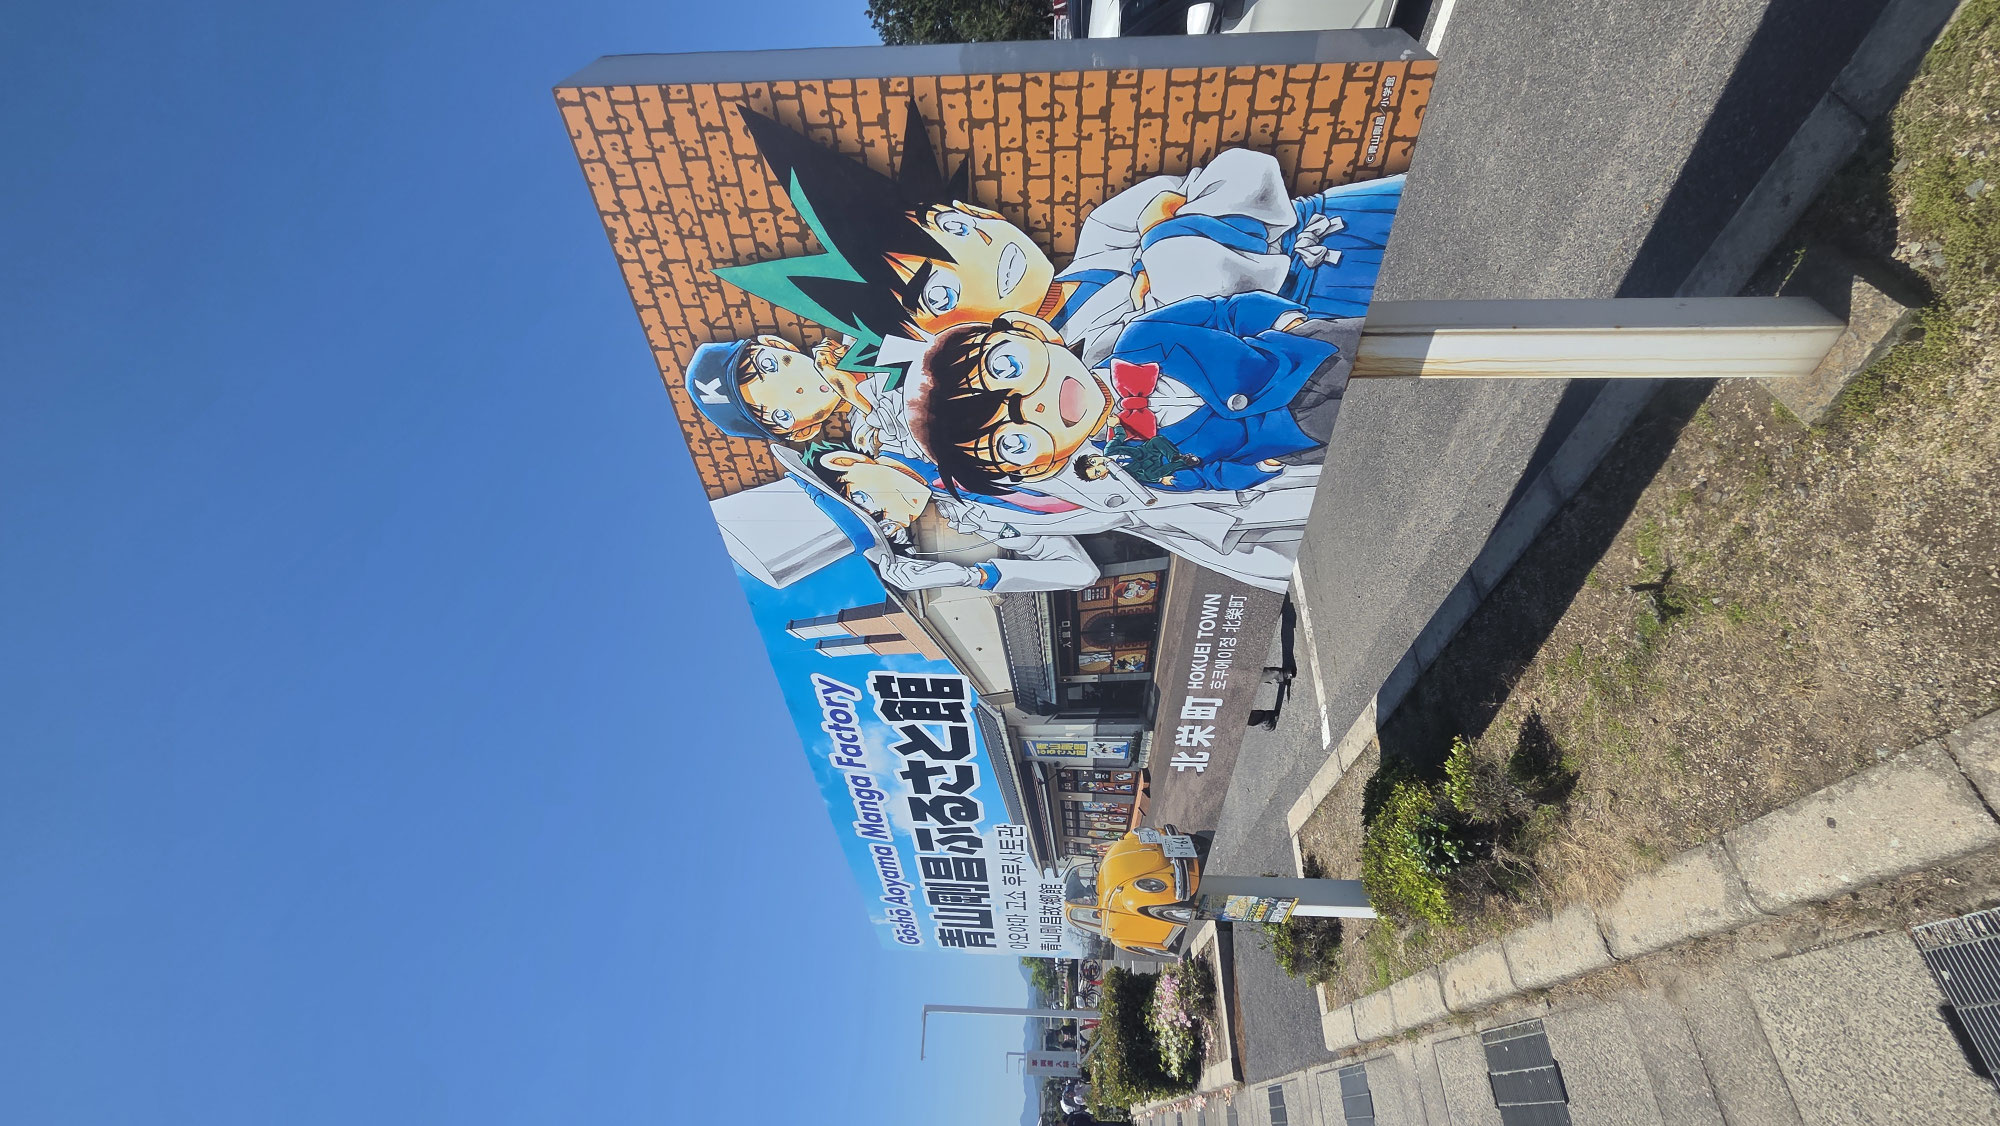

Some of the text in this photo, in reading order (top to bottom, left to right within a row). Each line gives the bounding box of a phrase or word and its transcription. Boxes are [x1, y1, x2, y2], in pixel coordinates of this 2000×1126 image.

[1187, 593, 1222, 689] HOKUEI TOWN
[1209, 637, 1237, 690] 호쿠에이정
[817, 677, 867, 768] Factory
[1170, 695, 1223, 773] 北栄町
[849, 775, 886, 839] Manga
[873, 674, 997, 949] 青山剛昌ふるさと館
[872, 846, 912, 905] Aoyama
[997, 825, 1030, 950] 아오야마 고쇼 후루사토관
